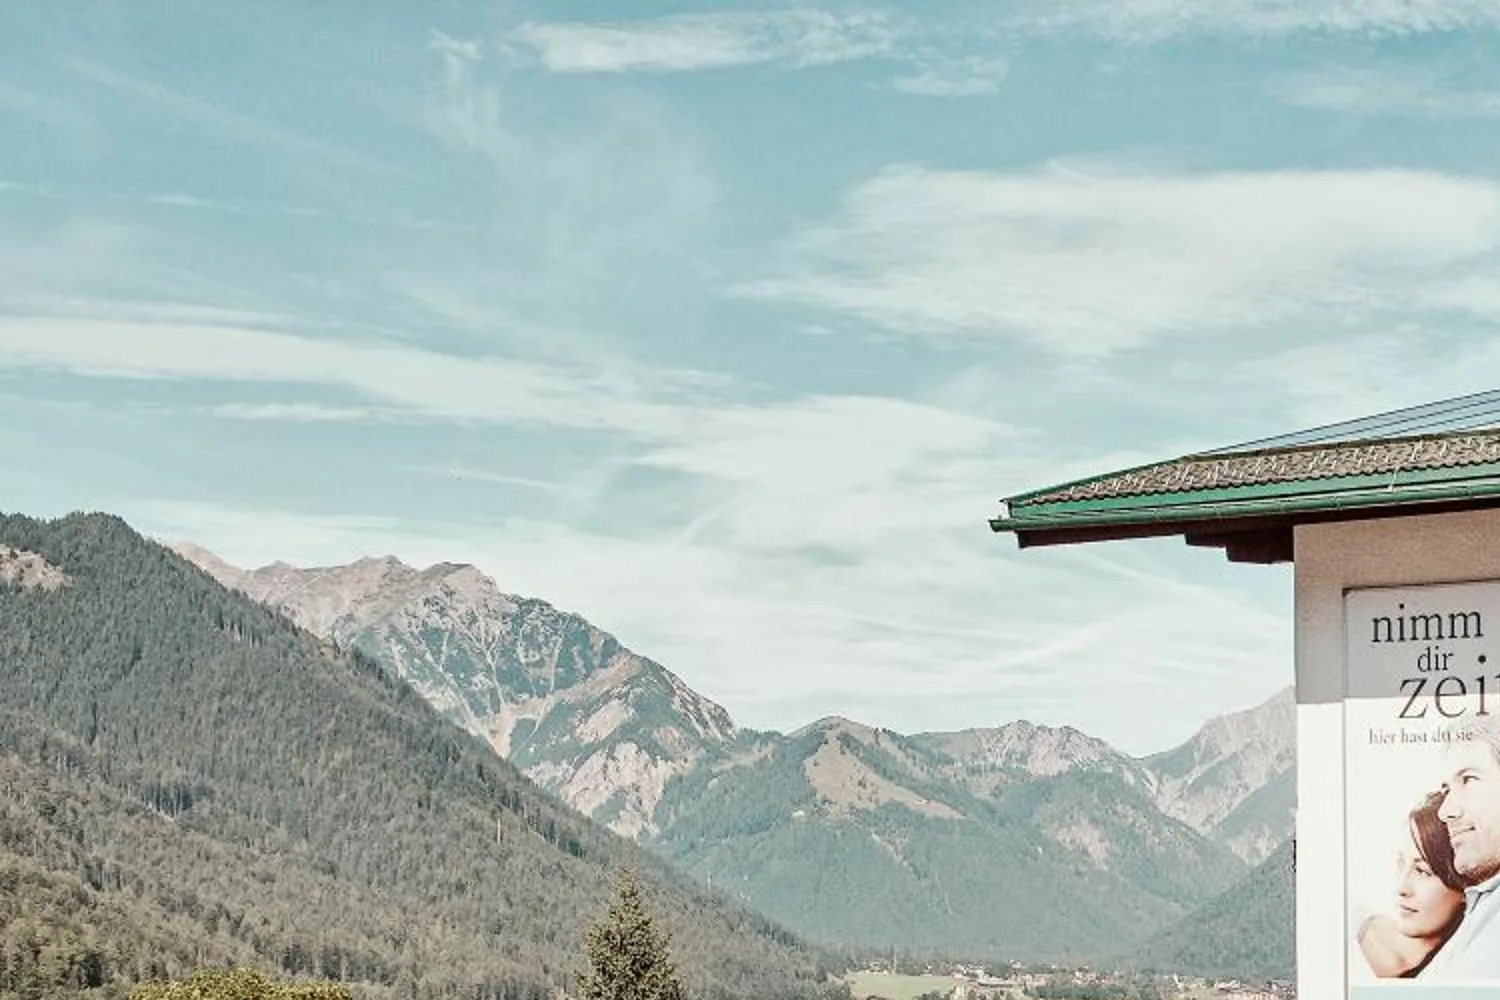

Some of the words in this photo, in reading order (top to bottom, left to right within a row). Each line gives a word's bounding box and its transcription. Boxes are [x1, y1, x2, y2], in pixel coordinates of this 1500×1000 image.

[1371, 603, 1485, 643] nimm
[1417, 645, 1455, 673] dir
[1368, 728, 1397, 745] hier
[1401, 727, 1427, 743] hast
[1430, 725, 1451, 743] du
[1455, 727, 1473, 741] sie
